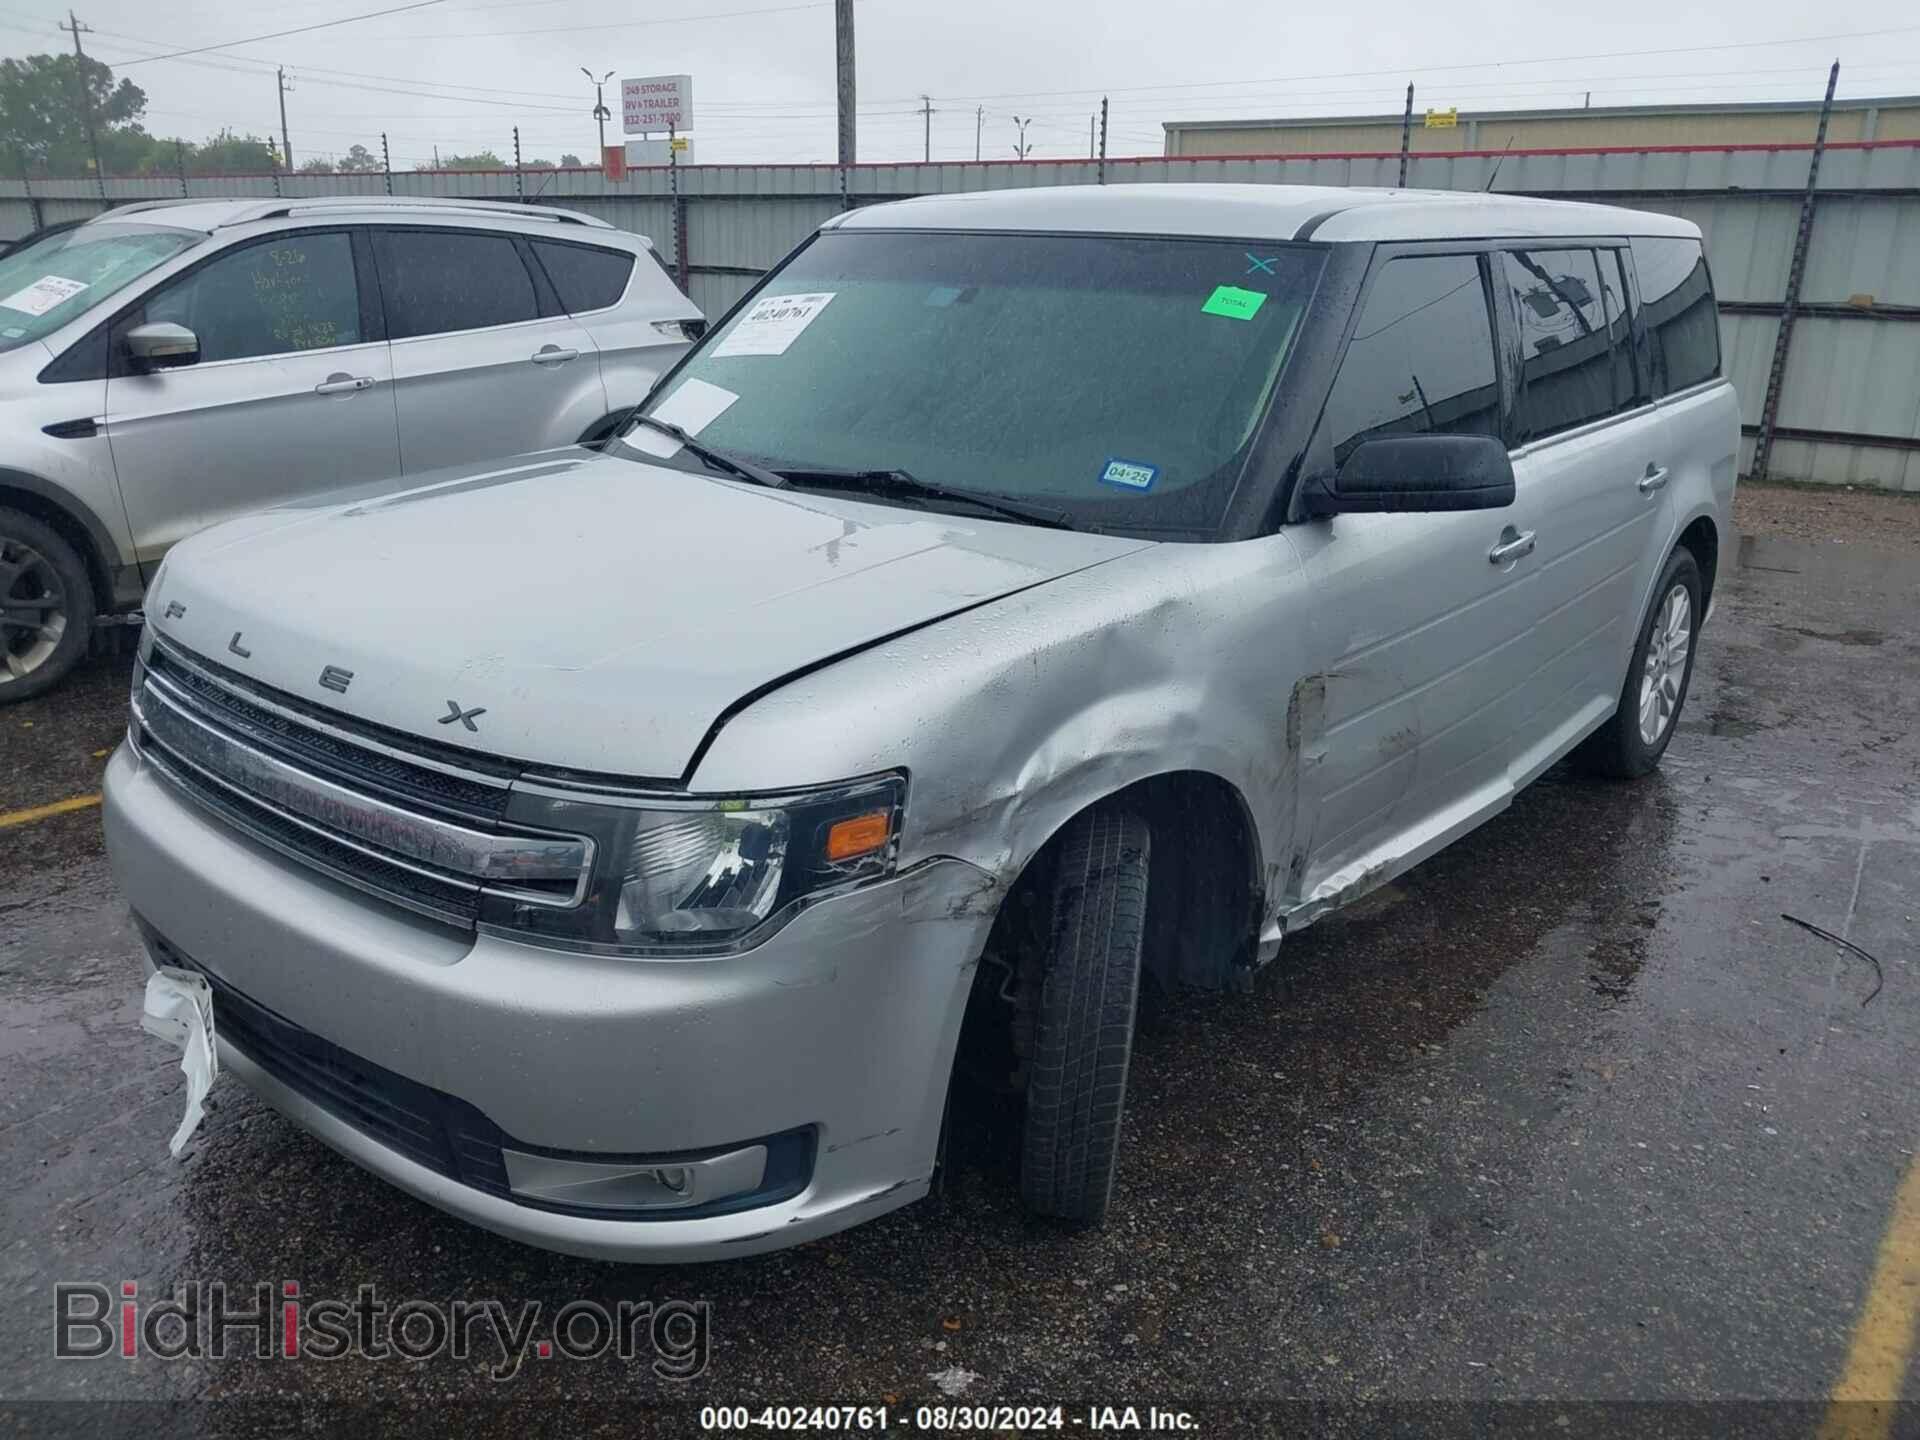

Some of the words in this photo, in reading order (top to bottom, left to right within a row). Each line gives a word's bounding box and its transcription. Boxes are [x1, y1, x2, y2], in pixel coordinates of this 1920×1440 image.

[641, 83, 677, 94] STORAGE
[625, 100, 637, 110] RV
[643, 98, 680, 109] TRAILER
[165, 600, 486, 732] FLEX
